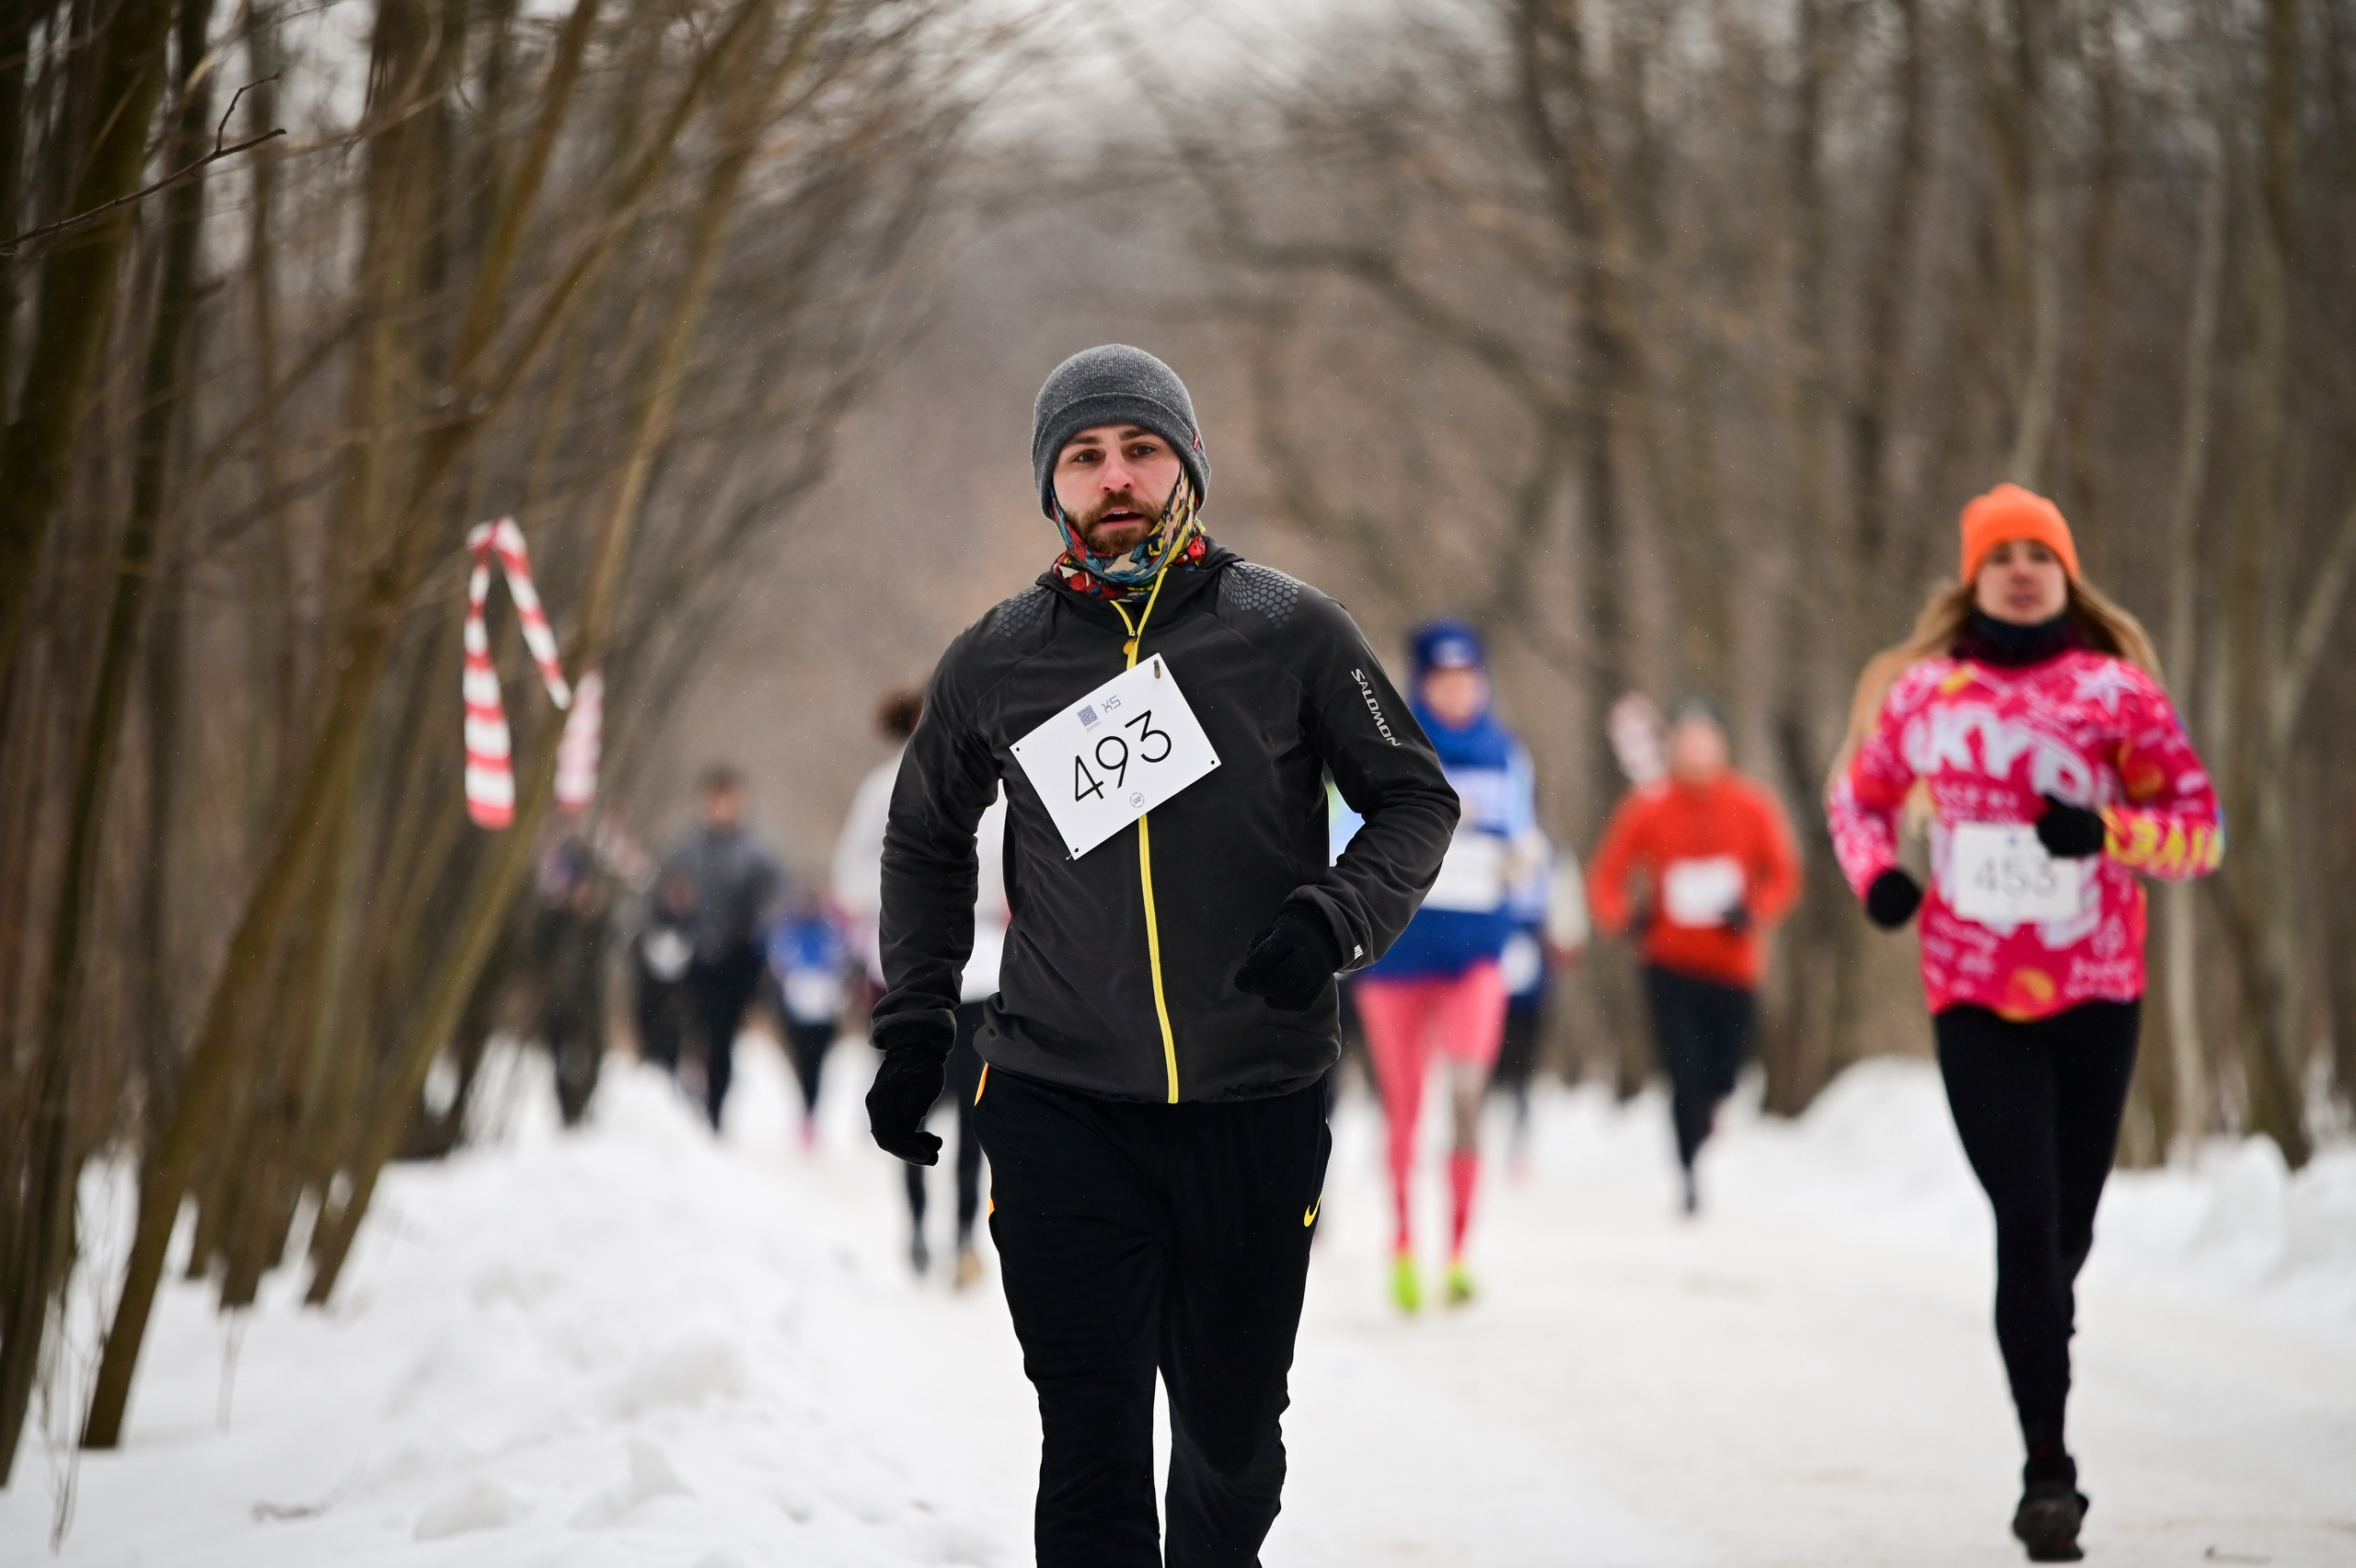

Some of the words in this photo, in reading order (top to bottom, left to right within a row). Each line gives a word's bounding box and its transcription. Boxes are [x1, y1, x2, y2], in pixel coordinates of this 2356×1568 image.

[1351, 669, 1402, 747] SALOMON
[1075, 709, 1172, 802] 493
[1972, 855, 2060, 900] 453
